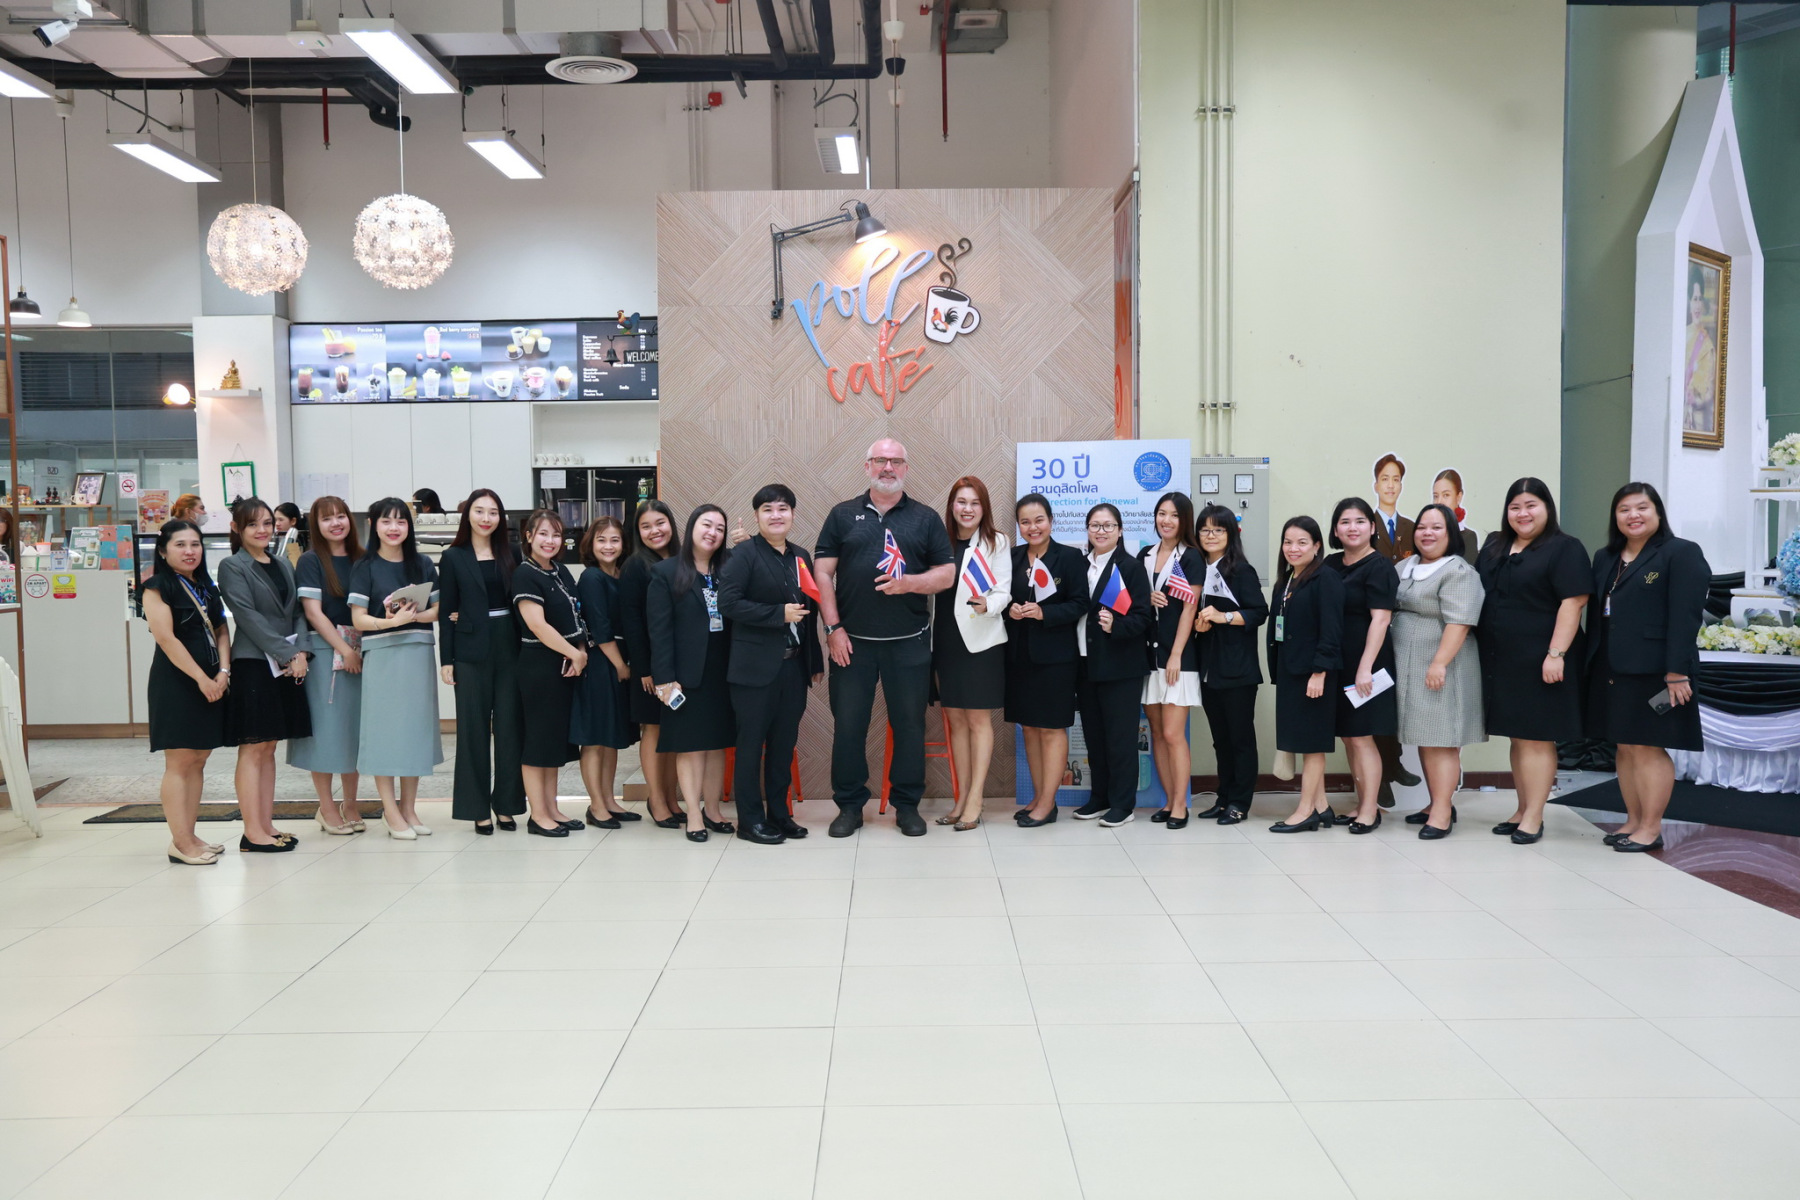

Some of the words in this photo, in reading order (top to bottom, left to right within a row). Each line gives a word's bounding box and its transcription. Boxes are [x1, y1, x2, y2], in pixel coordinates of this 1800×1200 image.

[790, 247, 935, 368] poll
[626, 351, 659, 362] WELCOME
[1032, 458, 1065, 480] 30
[1072, 453, 1090, 478] ปี
[1030, 480, 1098, 497] สวนดุสิตโพล
[1084, 497, 1098, 506] for
[1100, 497, 1138, 505] Renewal
